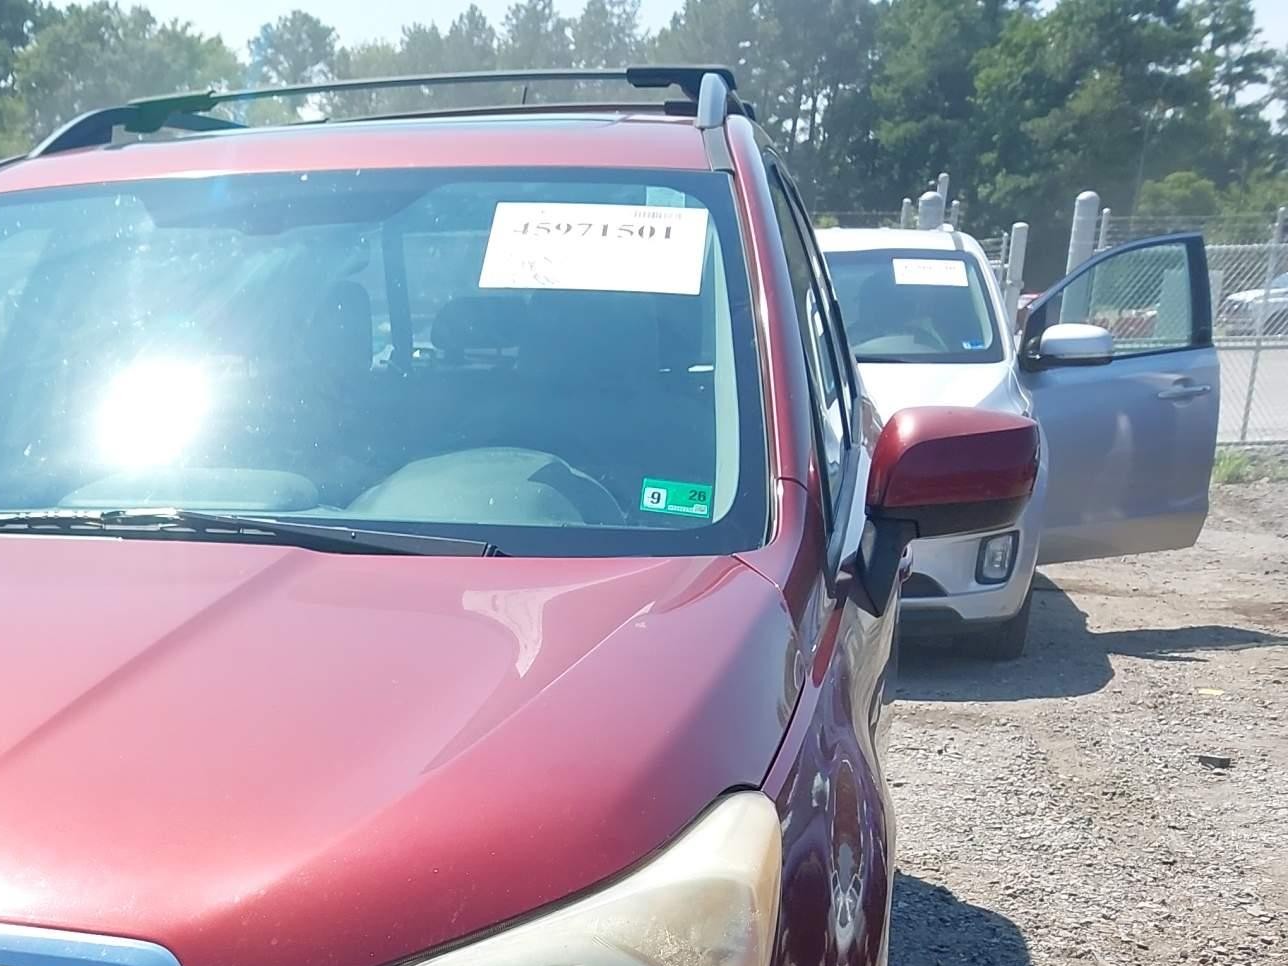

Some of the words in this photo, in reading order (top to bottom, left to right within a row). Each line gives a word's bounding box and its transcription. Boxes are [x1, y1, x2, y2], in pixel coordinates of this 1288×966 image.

[513, 222, 673, 240] 45971501
[651, 491, 661, 504] 9
[689, 490, 706, 502] 26
